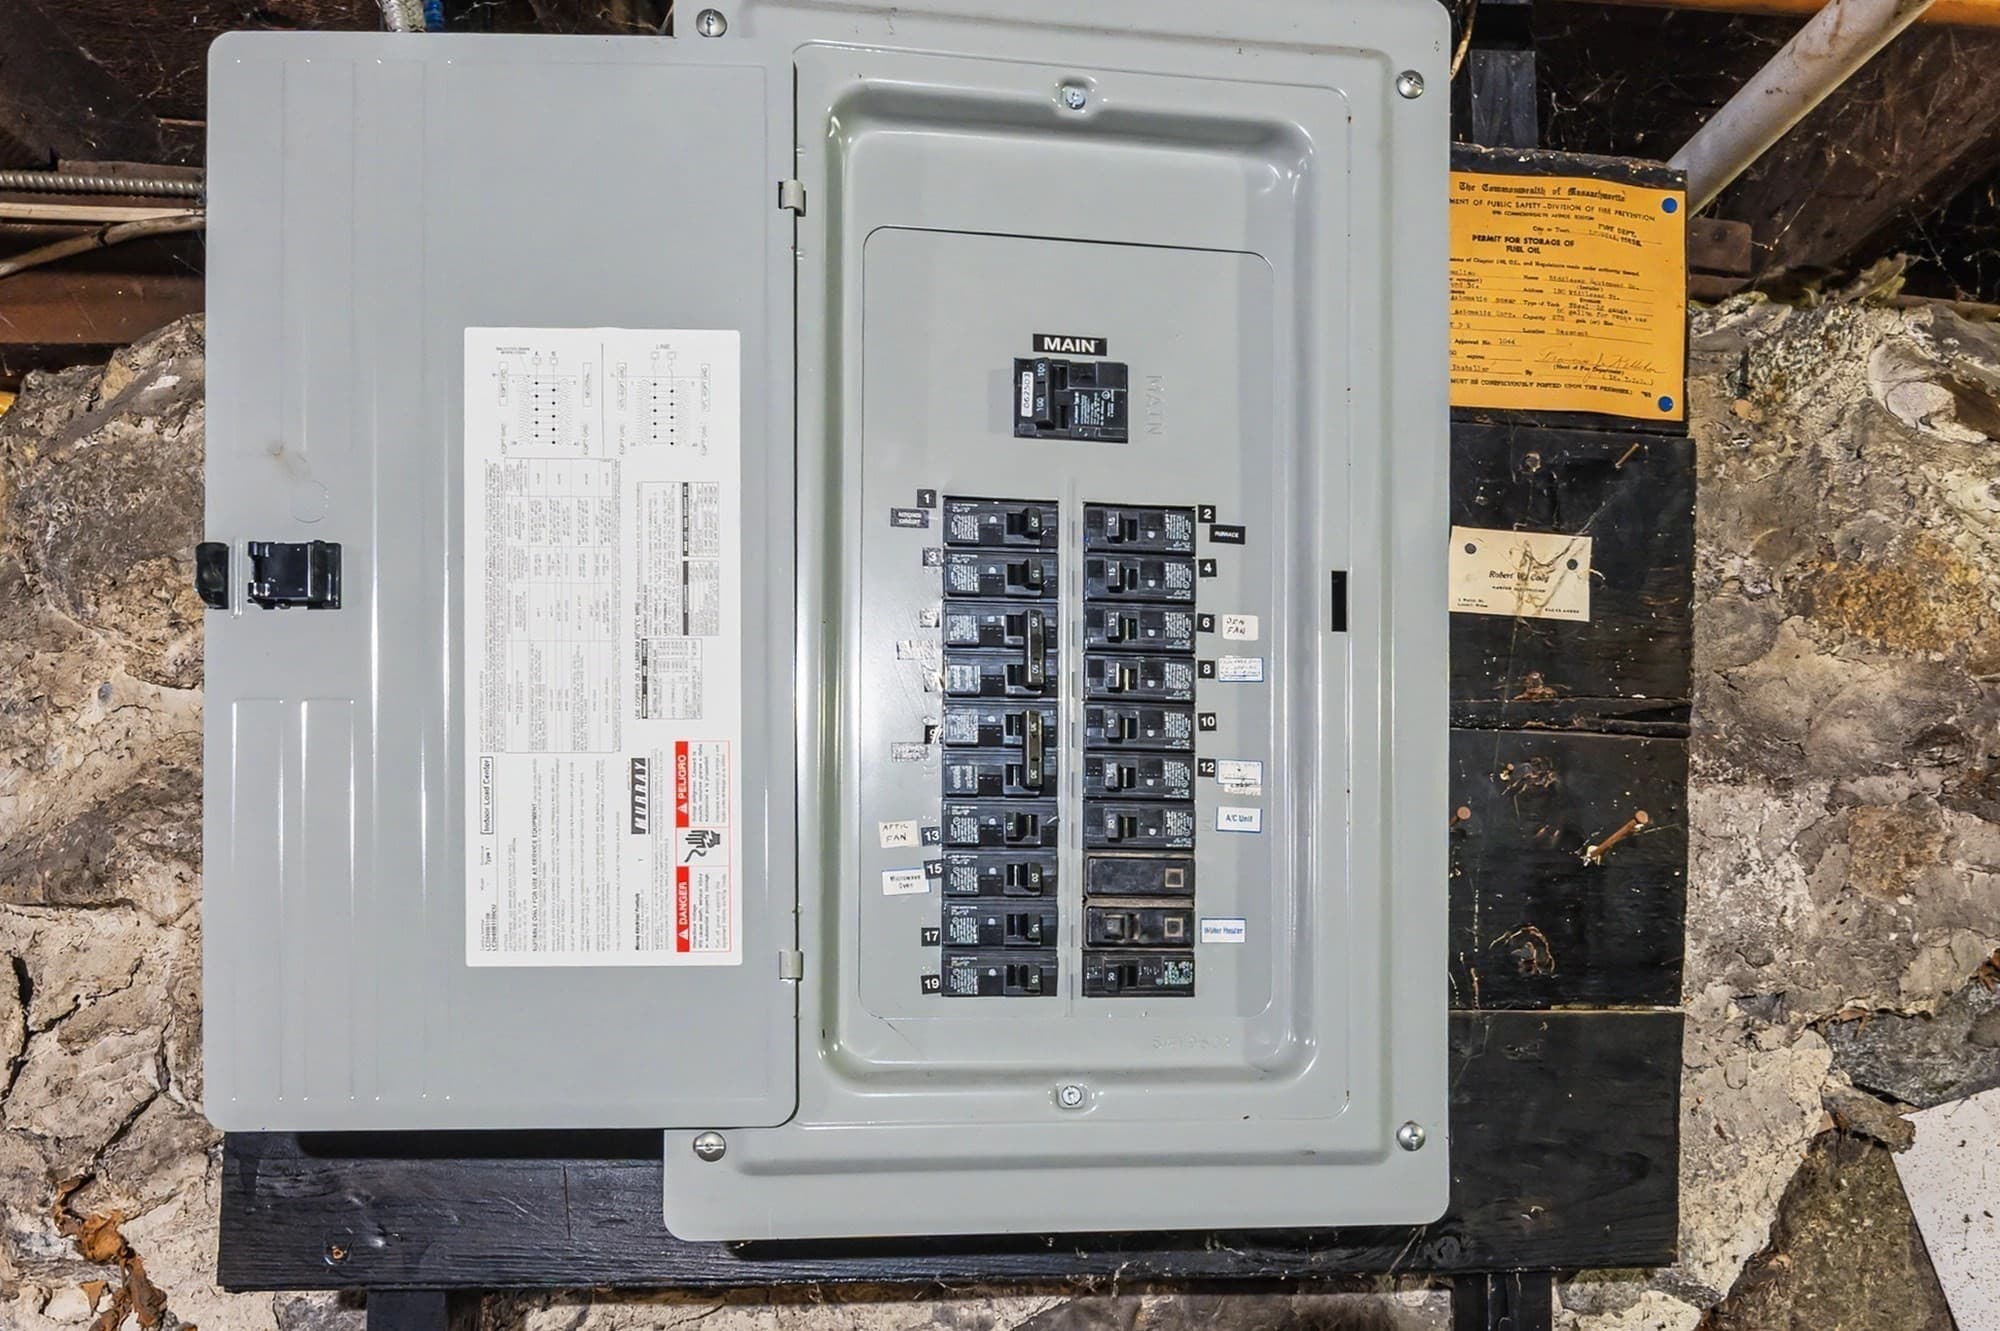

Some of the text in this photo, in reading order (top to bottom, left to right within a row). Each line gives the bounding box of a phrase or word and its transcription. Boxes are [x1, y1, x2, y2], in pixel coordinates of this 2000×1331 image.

[1458, 182, 1476, 192] The
[1482, 184, 1546, 196] Commonwealth
[1552, 186, 1560, 196] of
[1487, 200, 1512, 208] PUBLIC
[1614, 210, 1655, 222] PREVENTION
[1472, 234, 1501, 242] PERMIT
[1524, 238, 1560, 246] STORAGE
[1506, 245, 1524, 253] FUEL
[1044, 337, 1095, 352] MAIN
[1036, 397, 1044, 412] 100
[924, 493, 930, 504] 1
[1204, 508, 1212, 519] 2
[928, 551, 936, 560] 3
[1204, 562, 1212, 573] 4
[1489, 570, 1513, 578] Robert
[1202, 618, 1210, 628] 6
[1203, 664, 1211, 674] 8
[1201, 716, 1215, 727] 10
[1200, 762, 1214, 772] 12
[678, 754, 687, 799] PELIGRO
[634, 761, 646, 830] MURRAY
[925, 831, 940, 841] 13
[928, 863, 942, 874] 15
[679, 881, 688, 925] DANGER
[924, 931, 939, 941] 17
[924, 978, 940, 989] 19
